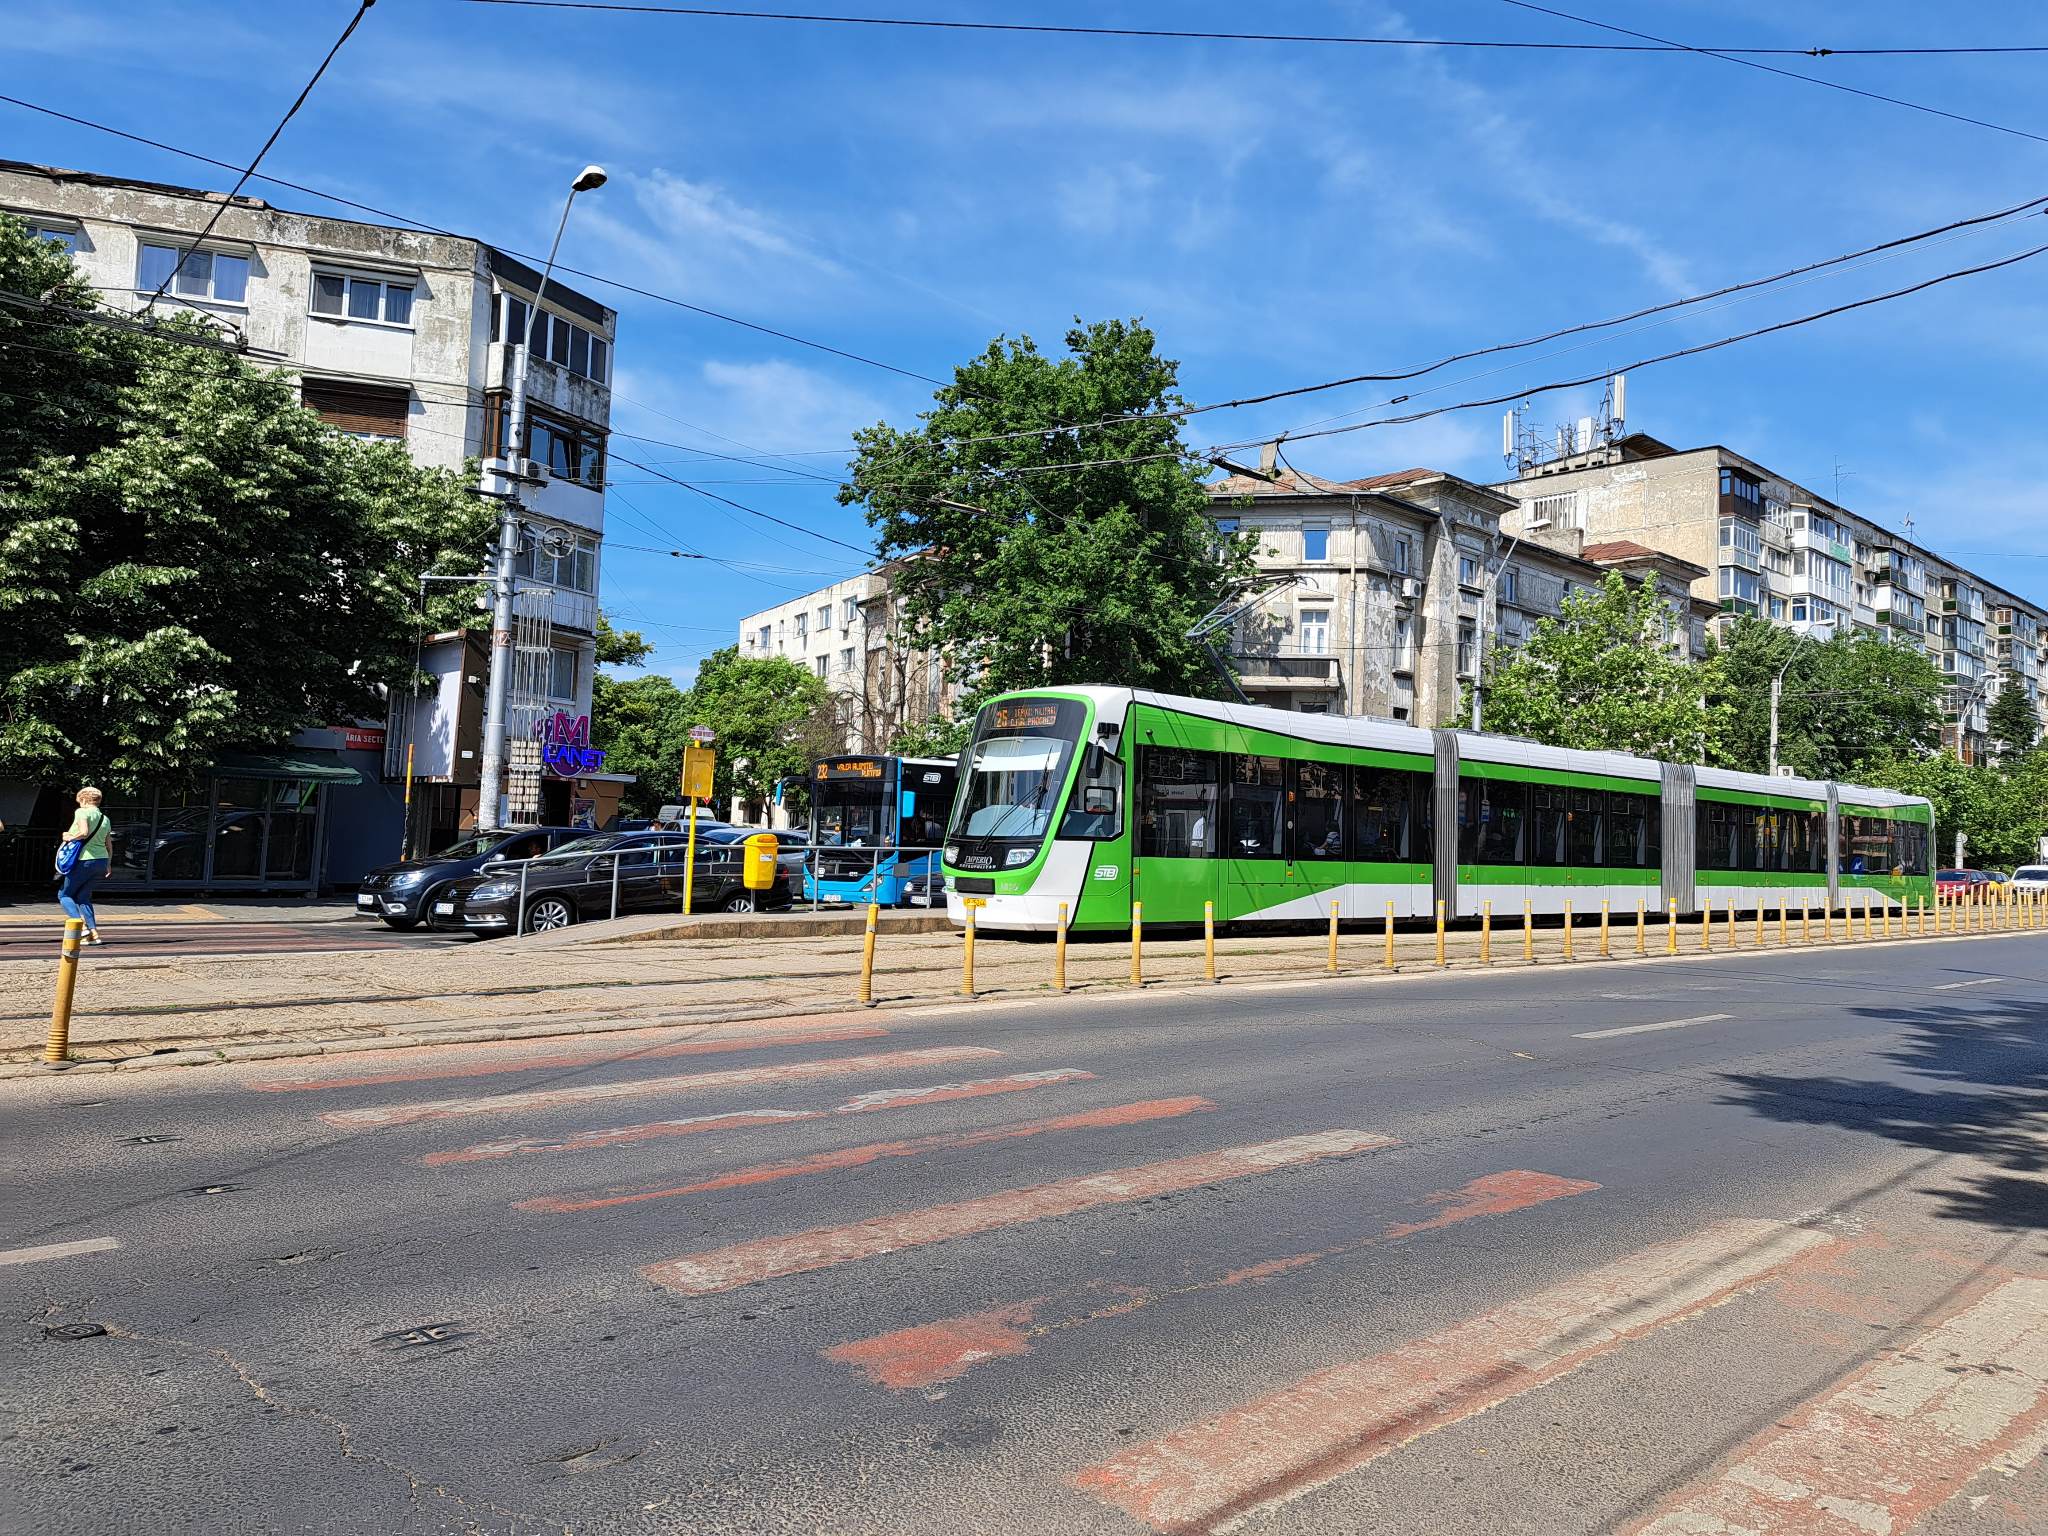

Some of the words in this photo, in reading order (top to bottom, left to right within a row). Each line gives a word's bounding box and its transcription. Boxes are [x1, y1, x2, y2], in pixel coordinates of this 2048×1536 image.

[817, 763, 828, 779] 232
[923, 773, 940, 782] STB
[964, 855, 992, 865] IMPERIO
[1094, 867, 1117, 879] STB
